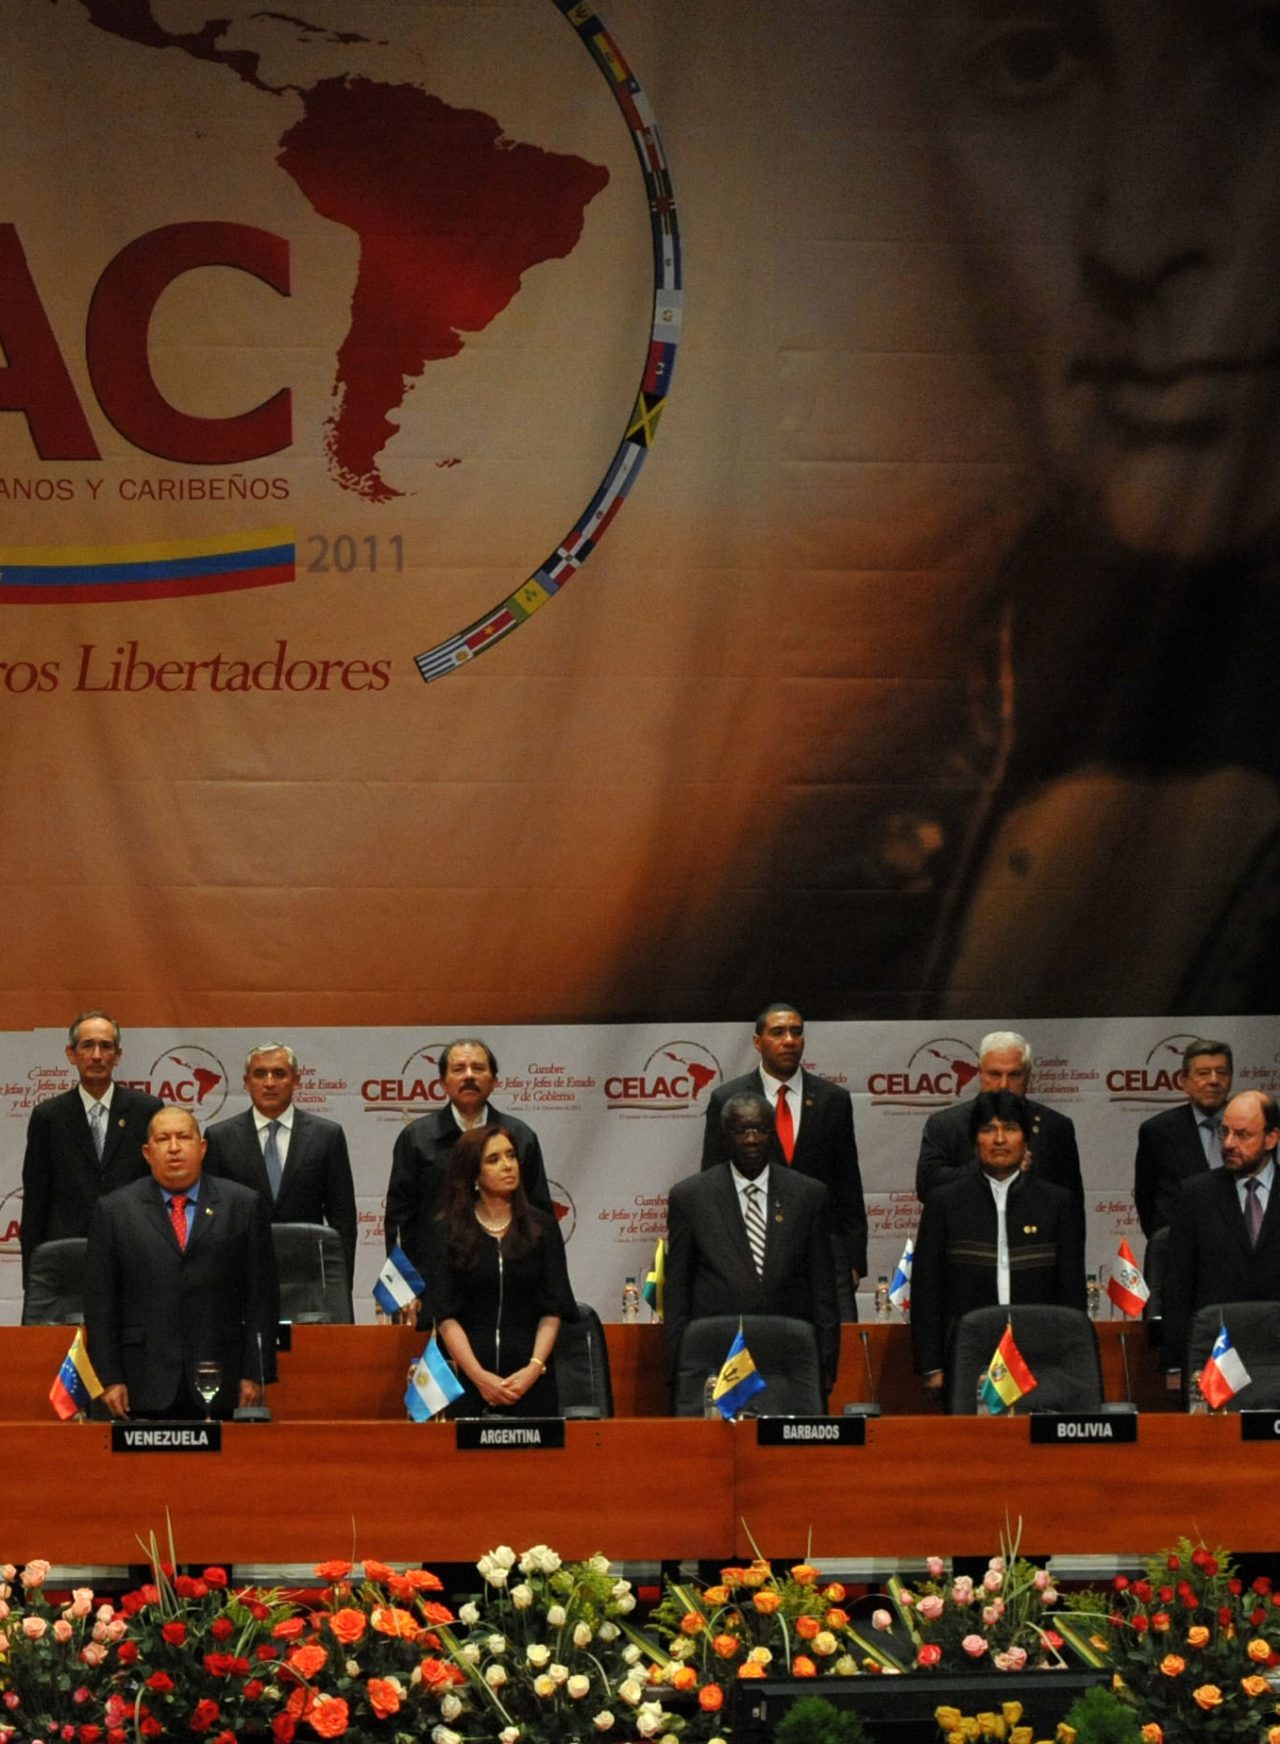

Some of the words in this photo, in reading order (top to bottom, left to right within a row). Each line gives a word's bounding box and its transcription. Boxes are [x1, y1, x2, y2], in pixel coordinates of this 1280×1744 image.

[86, 478, 104, 500] Y
[118, 472, 290, 501] CARIBEÑOS
[306, 533, 406, 574] 2011
[72, 639, 392, 694] Libertadores
[361, 1079, 446, 1101] CELAC
[566, 1075, 596, 1088] Estado
[604, 1076, 689, 1099] CELAC
[868, 1073, 953, 1095] CELAC
[292, 1092, 326, 1103] obierno
[124, 1430, 209, 1446] VENEZUELA
[480, 1429, 541, 1444] ARGENTINA
[783, 1425, 840, 1440] BARBADOS
[1057, 1423, 1113, 1438] BOLIVIA
